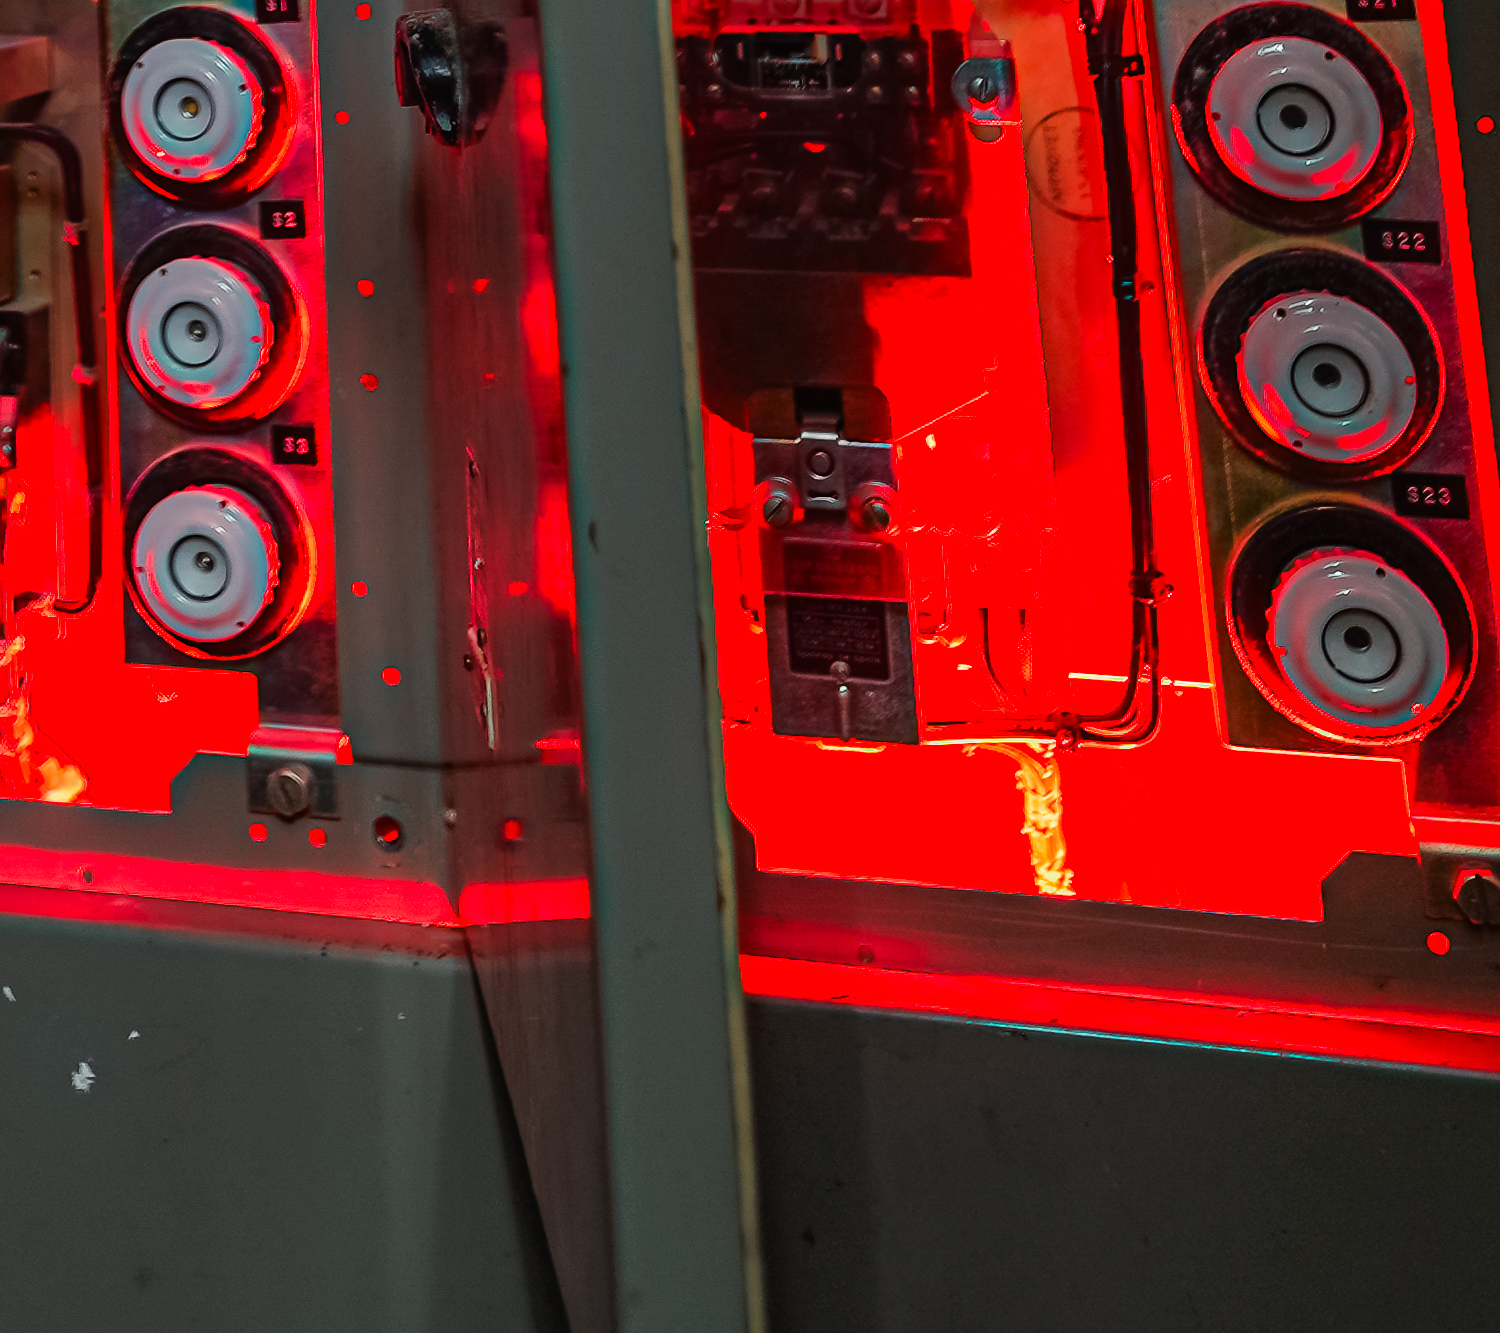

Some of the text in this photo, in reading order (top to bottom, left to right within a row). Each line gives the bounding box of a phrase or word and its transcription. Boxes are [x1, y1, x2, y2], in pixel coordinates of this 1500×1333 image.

[271, 210, 298, 229] S2
[1380, 229, 1427, 251] S22
[282, 436, 310, 456] S3
[1406, 484, 1453, 507] S23
